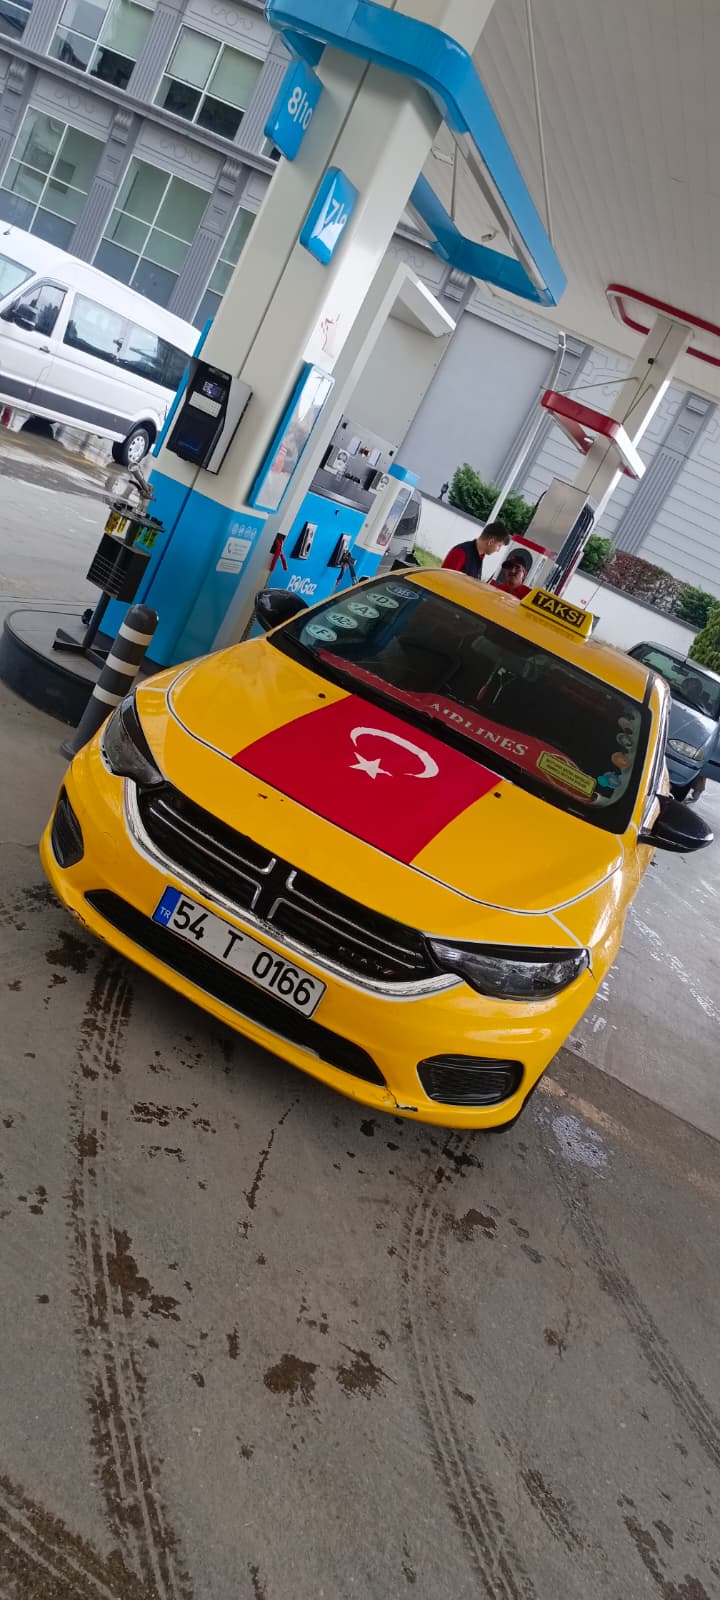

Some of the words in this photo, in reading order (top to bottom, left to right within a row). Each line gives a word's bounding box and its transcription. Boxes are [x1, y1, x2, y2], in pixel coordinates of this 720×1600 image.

[287, 86, 313, 130] 8/10
[160, 906, 171, 919] TR
[173, 900, 209, 941] 54
[222, 929, 244, 959] T
[251, 951, 316, 1006] 0166
